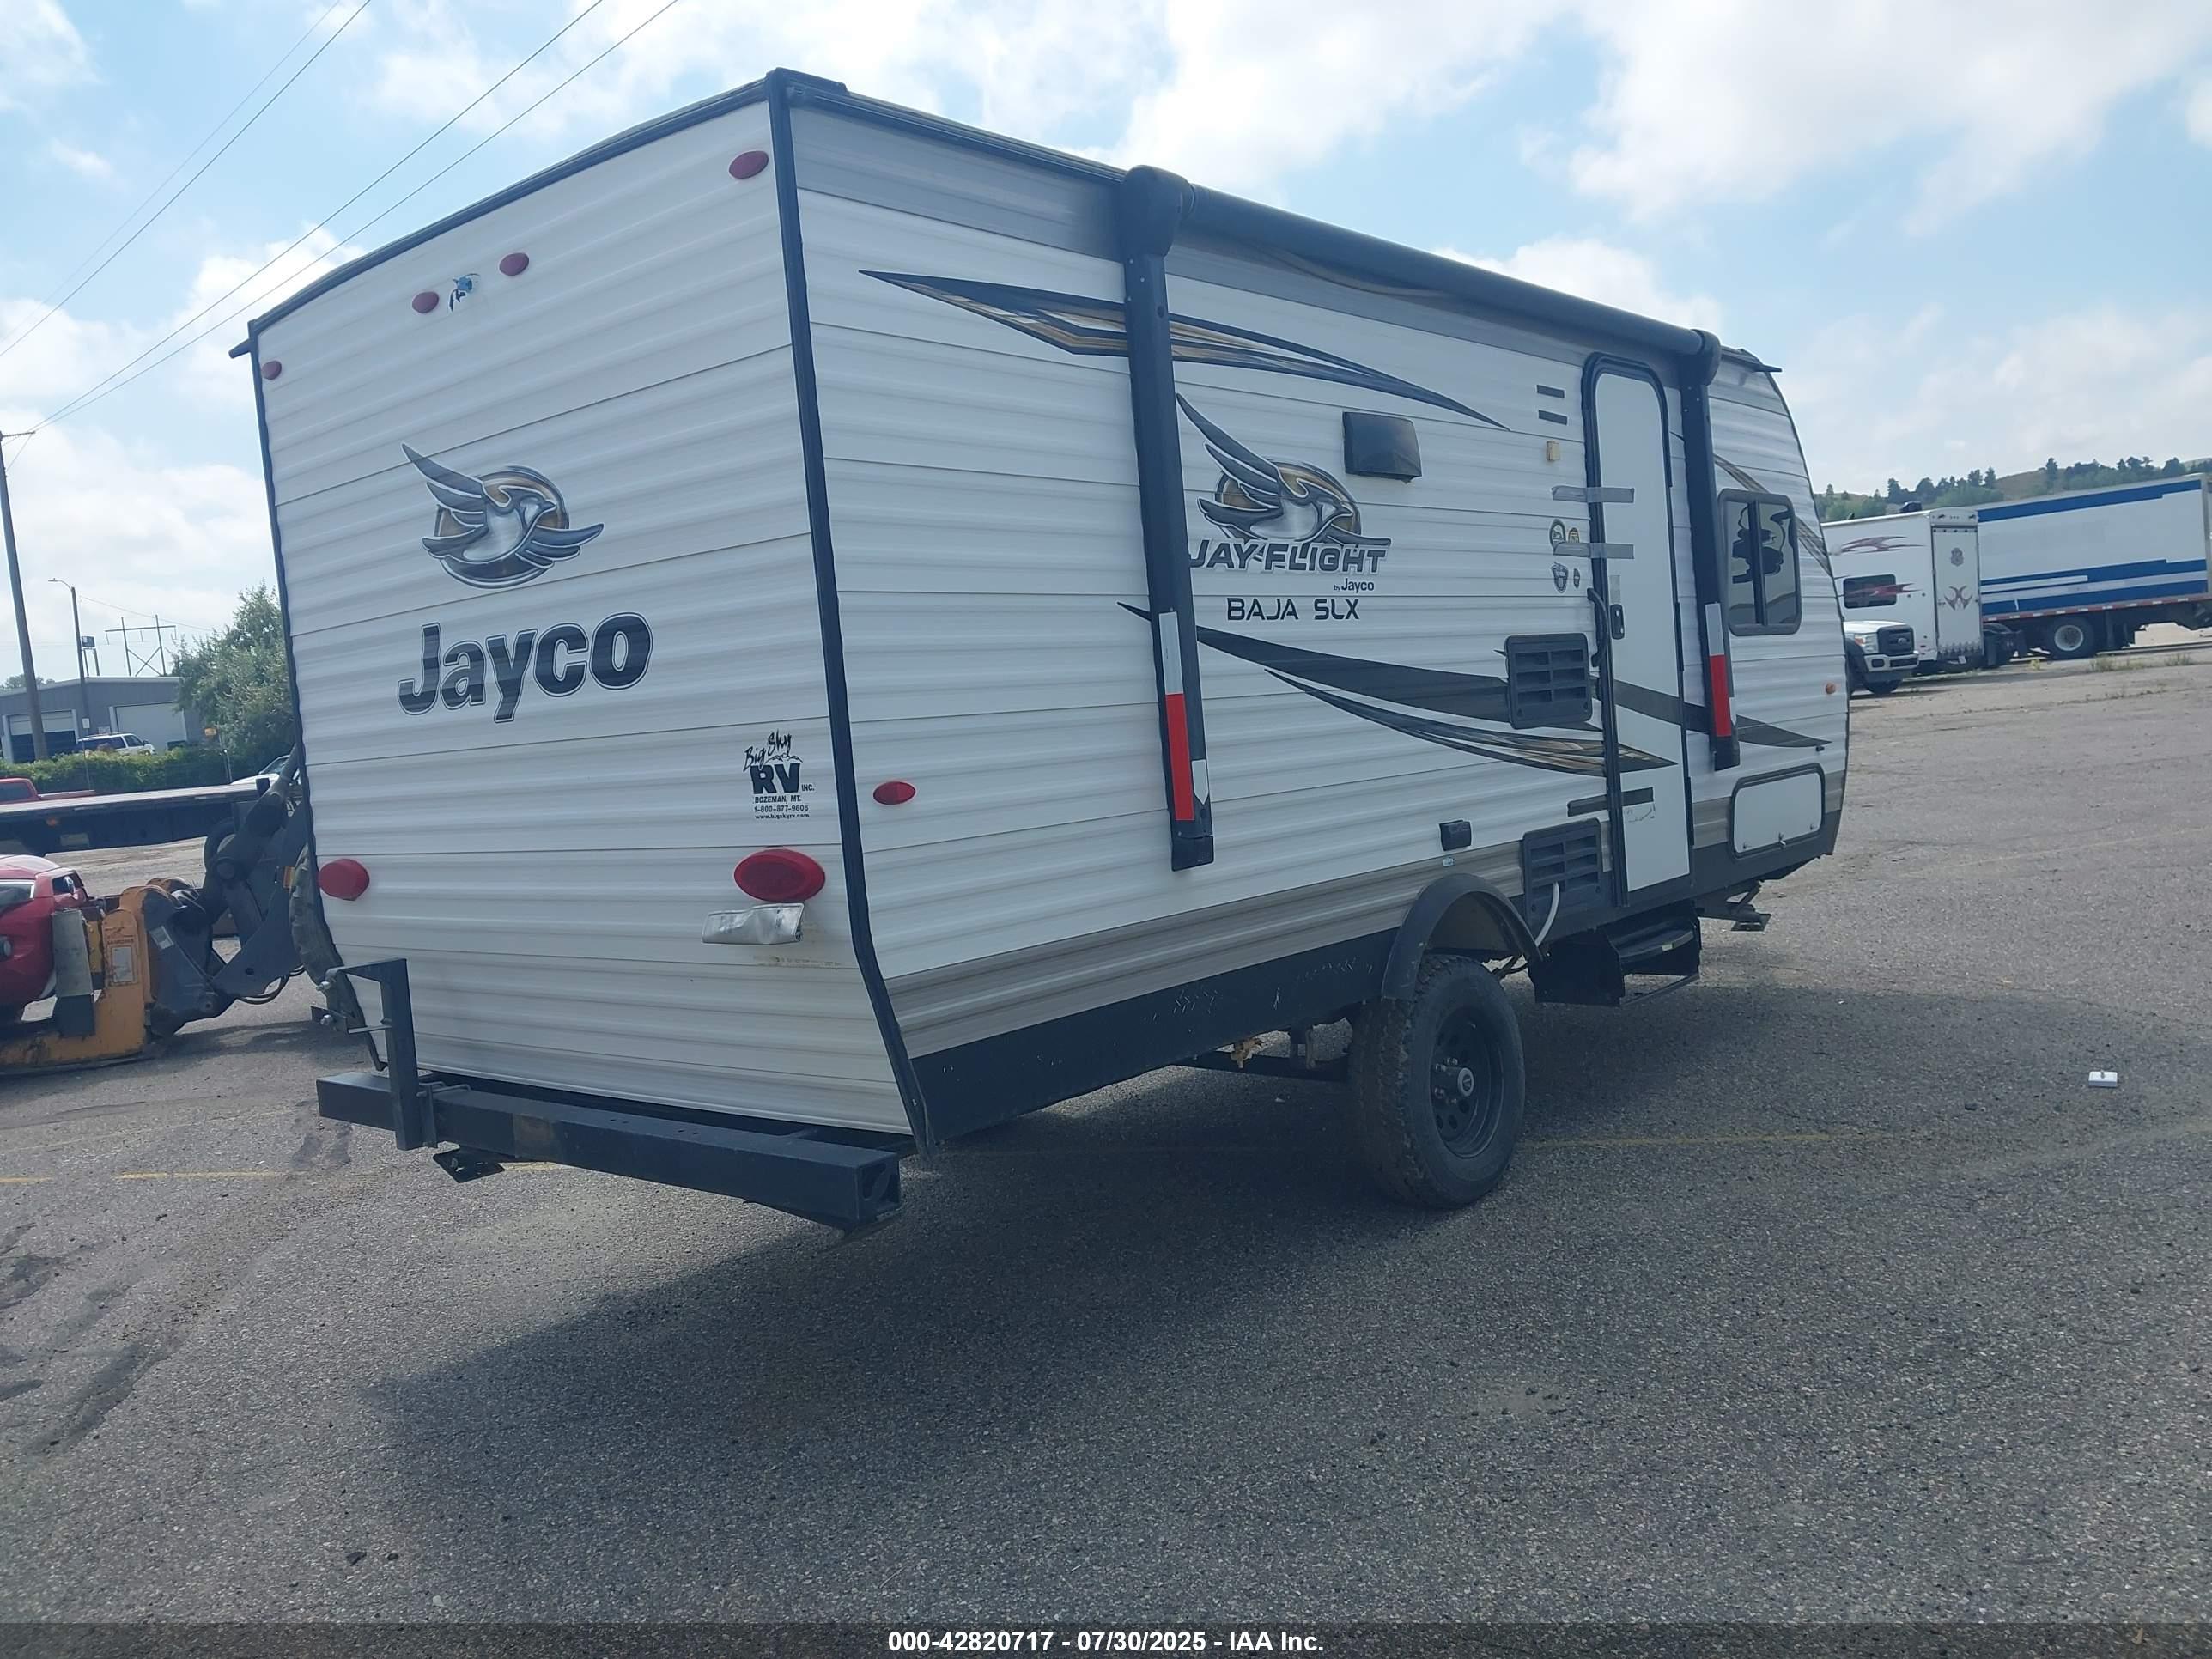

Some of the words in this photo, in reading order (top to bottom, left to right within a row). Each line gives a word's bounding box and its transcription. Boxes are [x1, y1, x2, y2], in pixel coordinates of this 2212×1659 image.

[1189, 538, 1261, 569] JAY
[1264, 542, 1387, 573] FLIGHT
[1341, 578, 1375, 593] Jayco
[1226, 597, 1299, 621] BAJA
[1314, 598, 1360, 621] SLX
[398, 611, 653, 723] Jayco
[743, 745, 767, 772] Big
[768, 728, 792, 757] Sky
[750, 763, 801, 794] RV
[801, 783, 815, 792] INC.
[754, 795, 788, 804] BOZEMAN,
[754, 804, 809, 812] 1-800-877-9606
